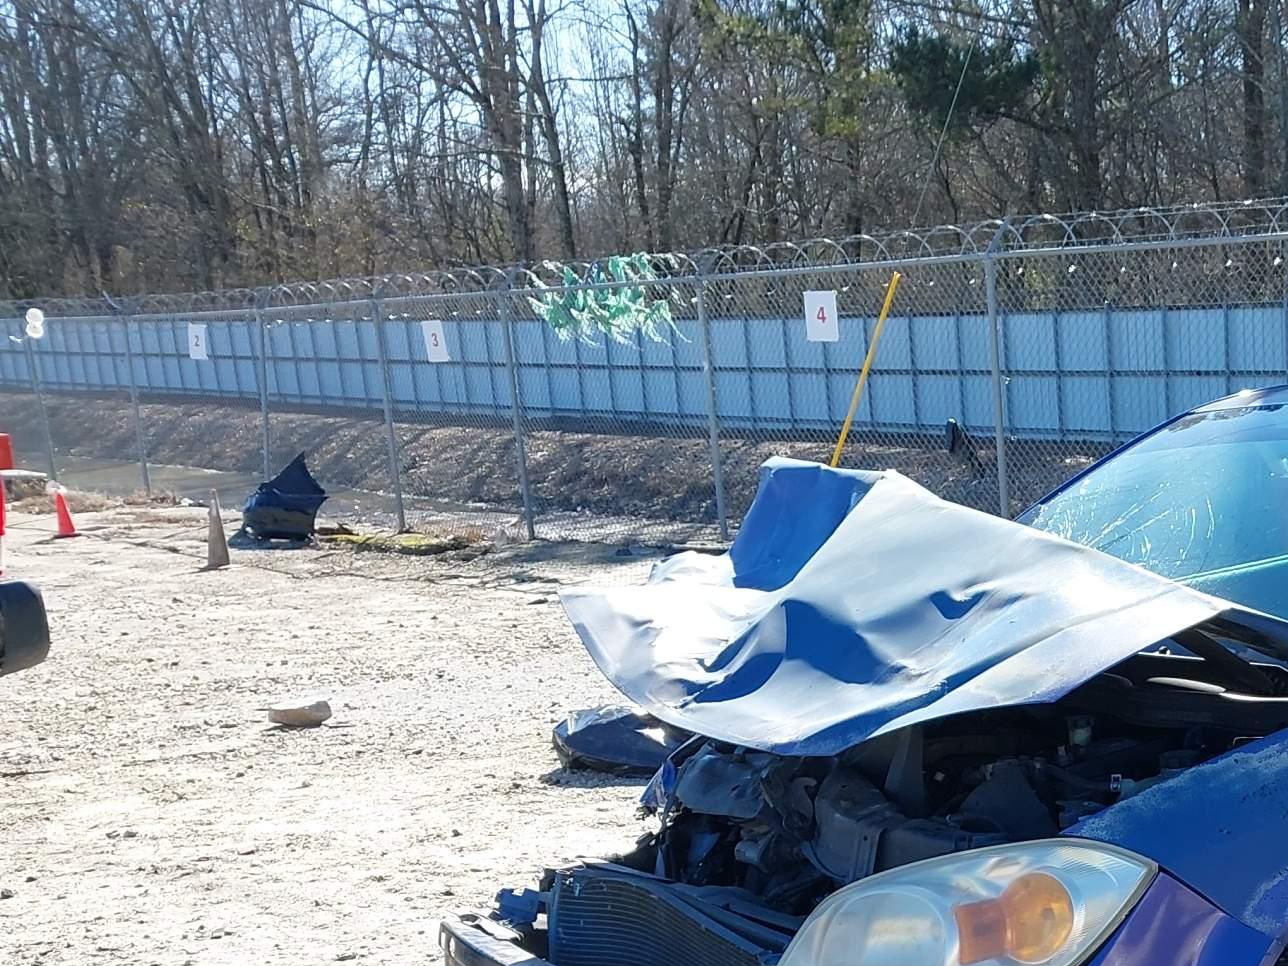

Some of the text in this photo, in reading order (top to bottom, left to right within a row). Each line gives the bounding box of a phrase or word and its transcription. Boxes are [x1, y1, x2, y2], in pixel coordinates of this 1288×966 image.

[816, 306, 827, 324] 4
[194, 334, 201, 347] 2
[431, 332, 439, 348] 3
